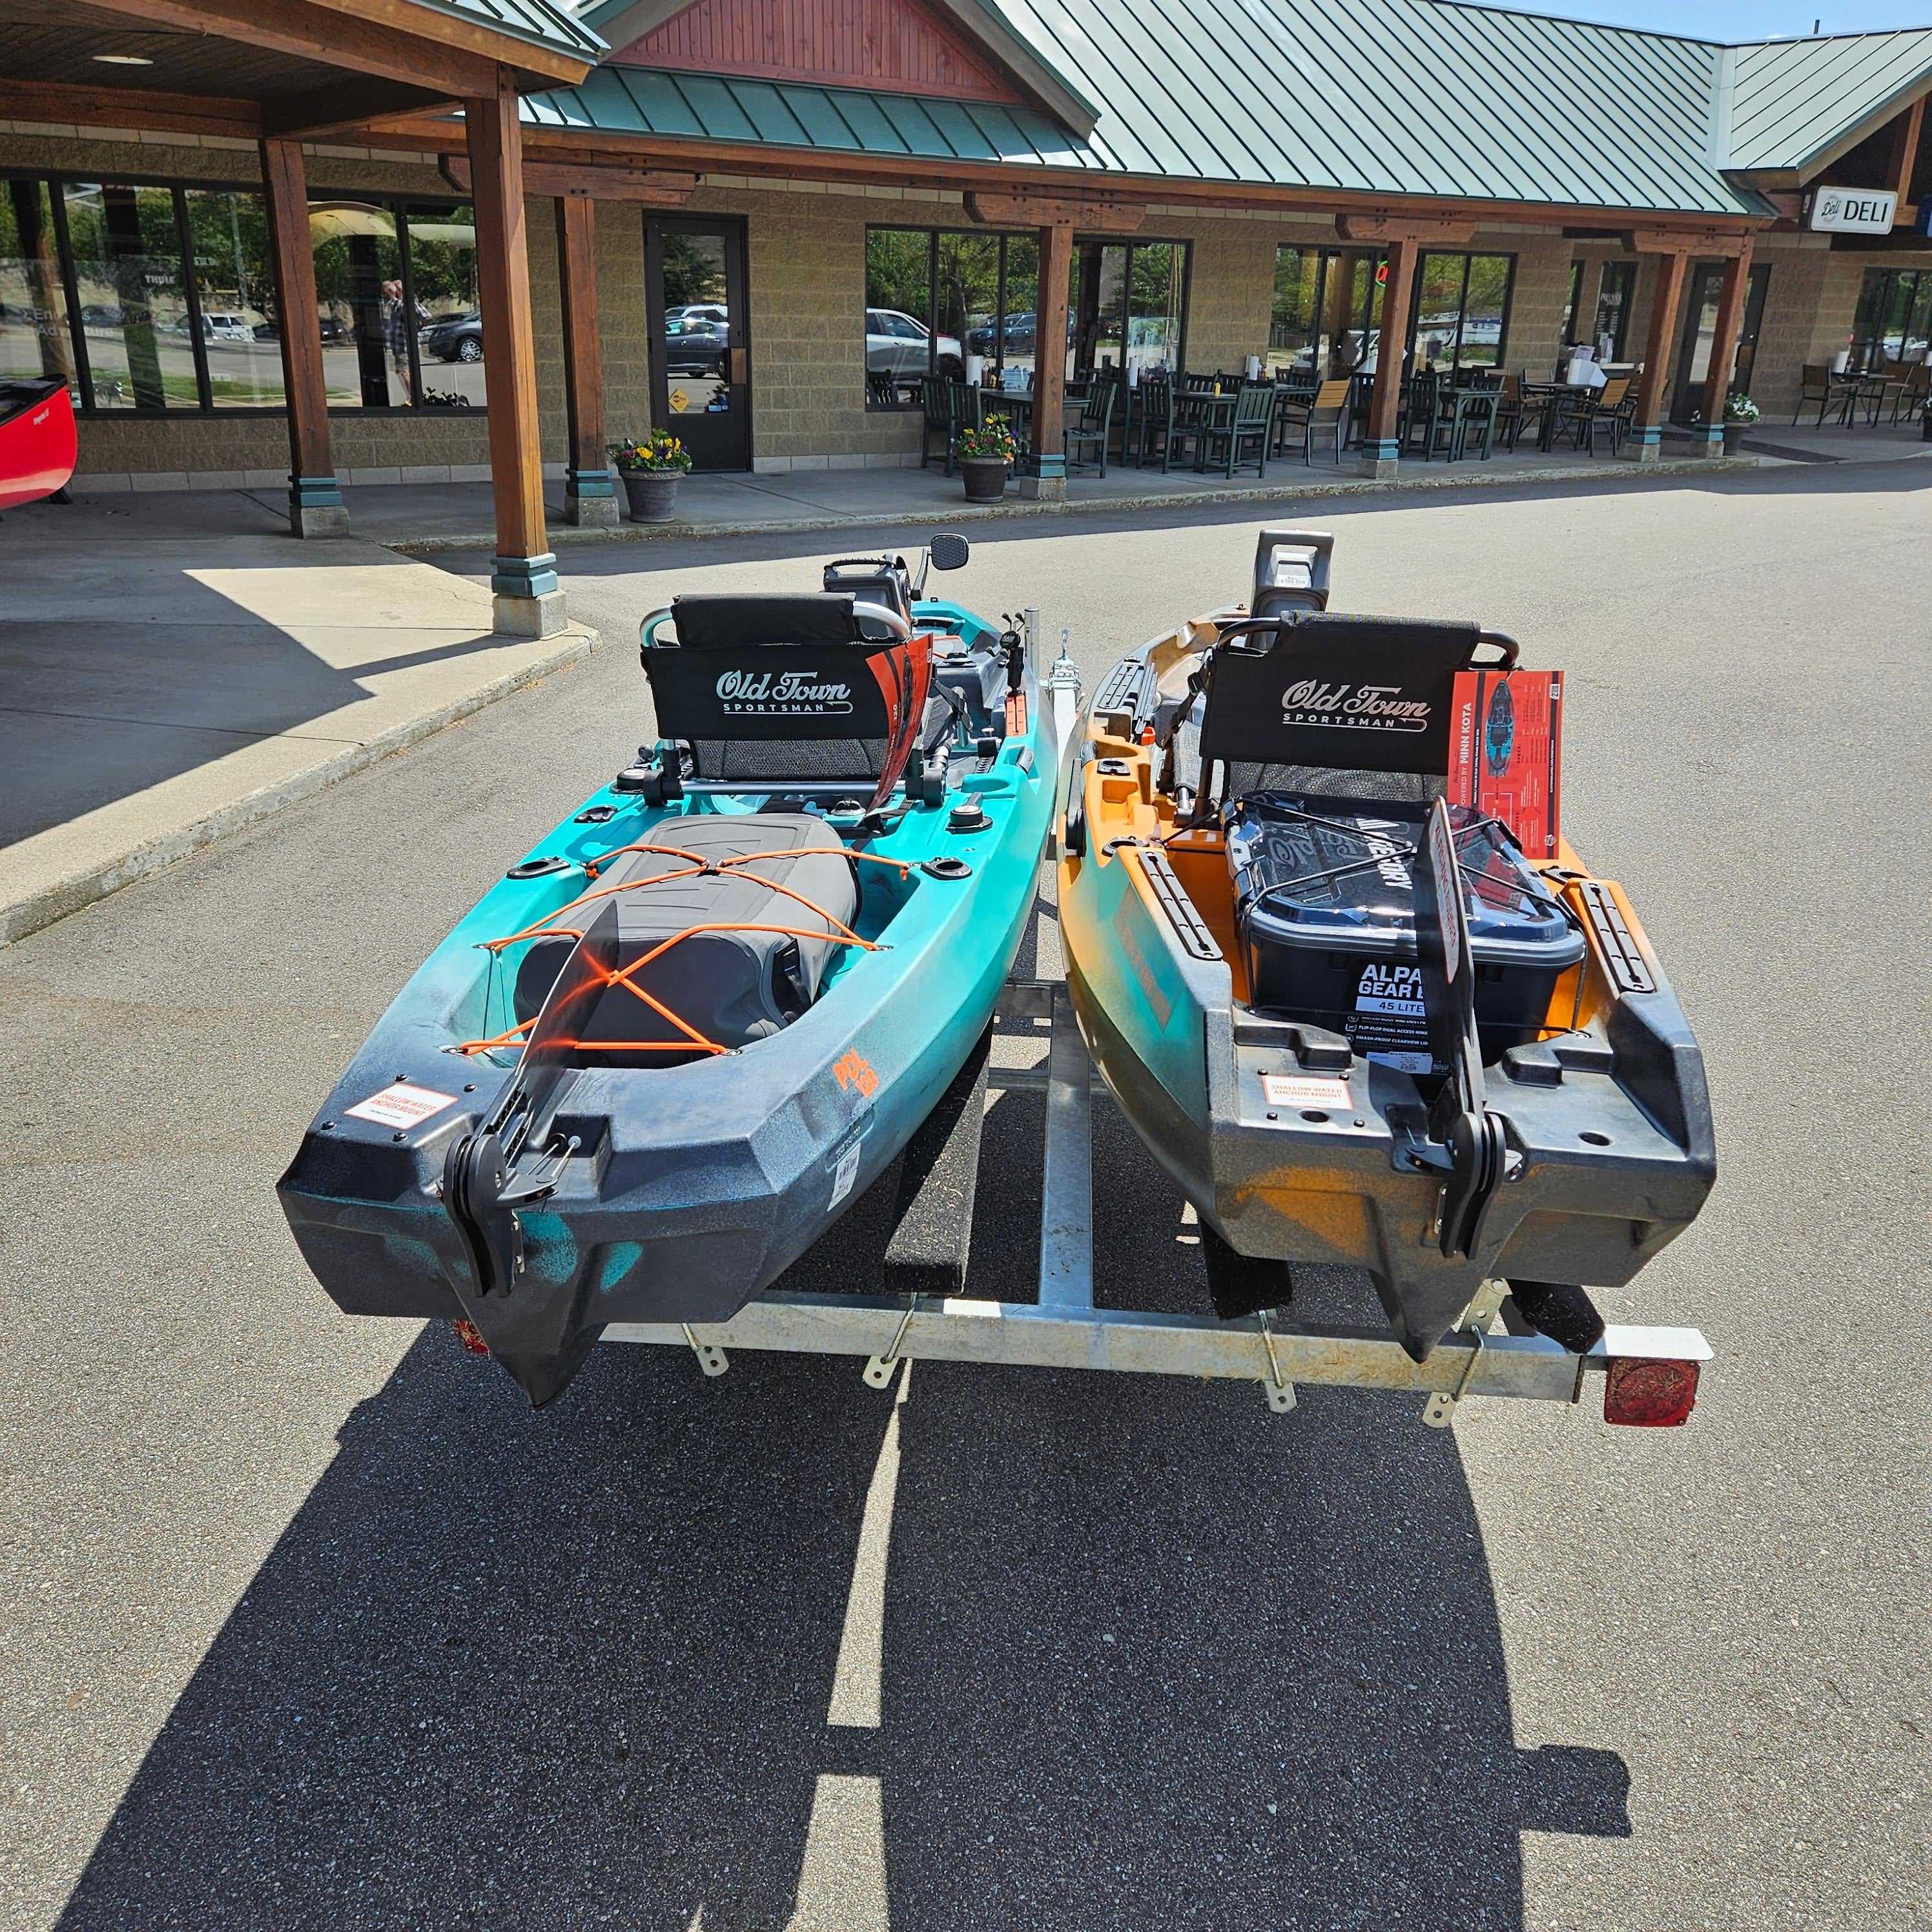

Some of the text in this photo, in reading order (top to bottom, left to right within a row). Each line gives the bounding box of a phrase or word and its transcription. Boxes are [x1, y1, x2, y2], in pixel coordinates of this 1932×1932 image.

[1844, 200, 1888, 222] DELI
[1002, 635, 1016, 643] RAM
[716, 669, 851, 701] Old Town
[723, 703, 823, 712] SPORTSMAN
[1282, 679, 1432, 717] Old Town
[1282, 712, 1395, 728] SPORTSMAN
[1461, 702, 1472, 734] KOTA
[1460, 735, 1470, 764] MINN
[1461, 766, 1468, 776] BY
[1361, 964, 1422, 985] ALPA
[1358, 981, 1412, 998] GEAR
[1379, 1002, 1424, 1013] 45 LITE
[833, 1047, 869, 1091] PDL
[370, 1099, 400, 1110] ANCHOR
[398, 1104, 427, 1117] MOUNT
[378, 1093, 437, 1112] SHALLOW WATER
